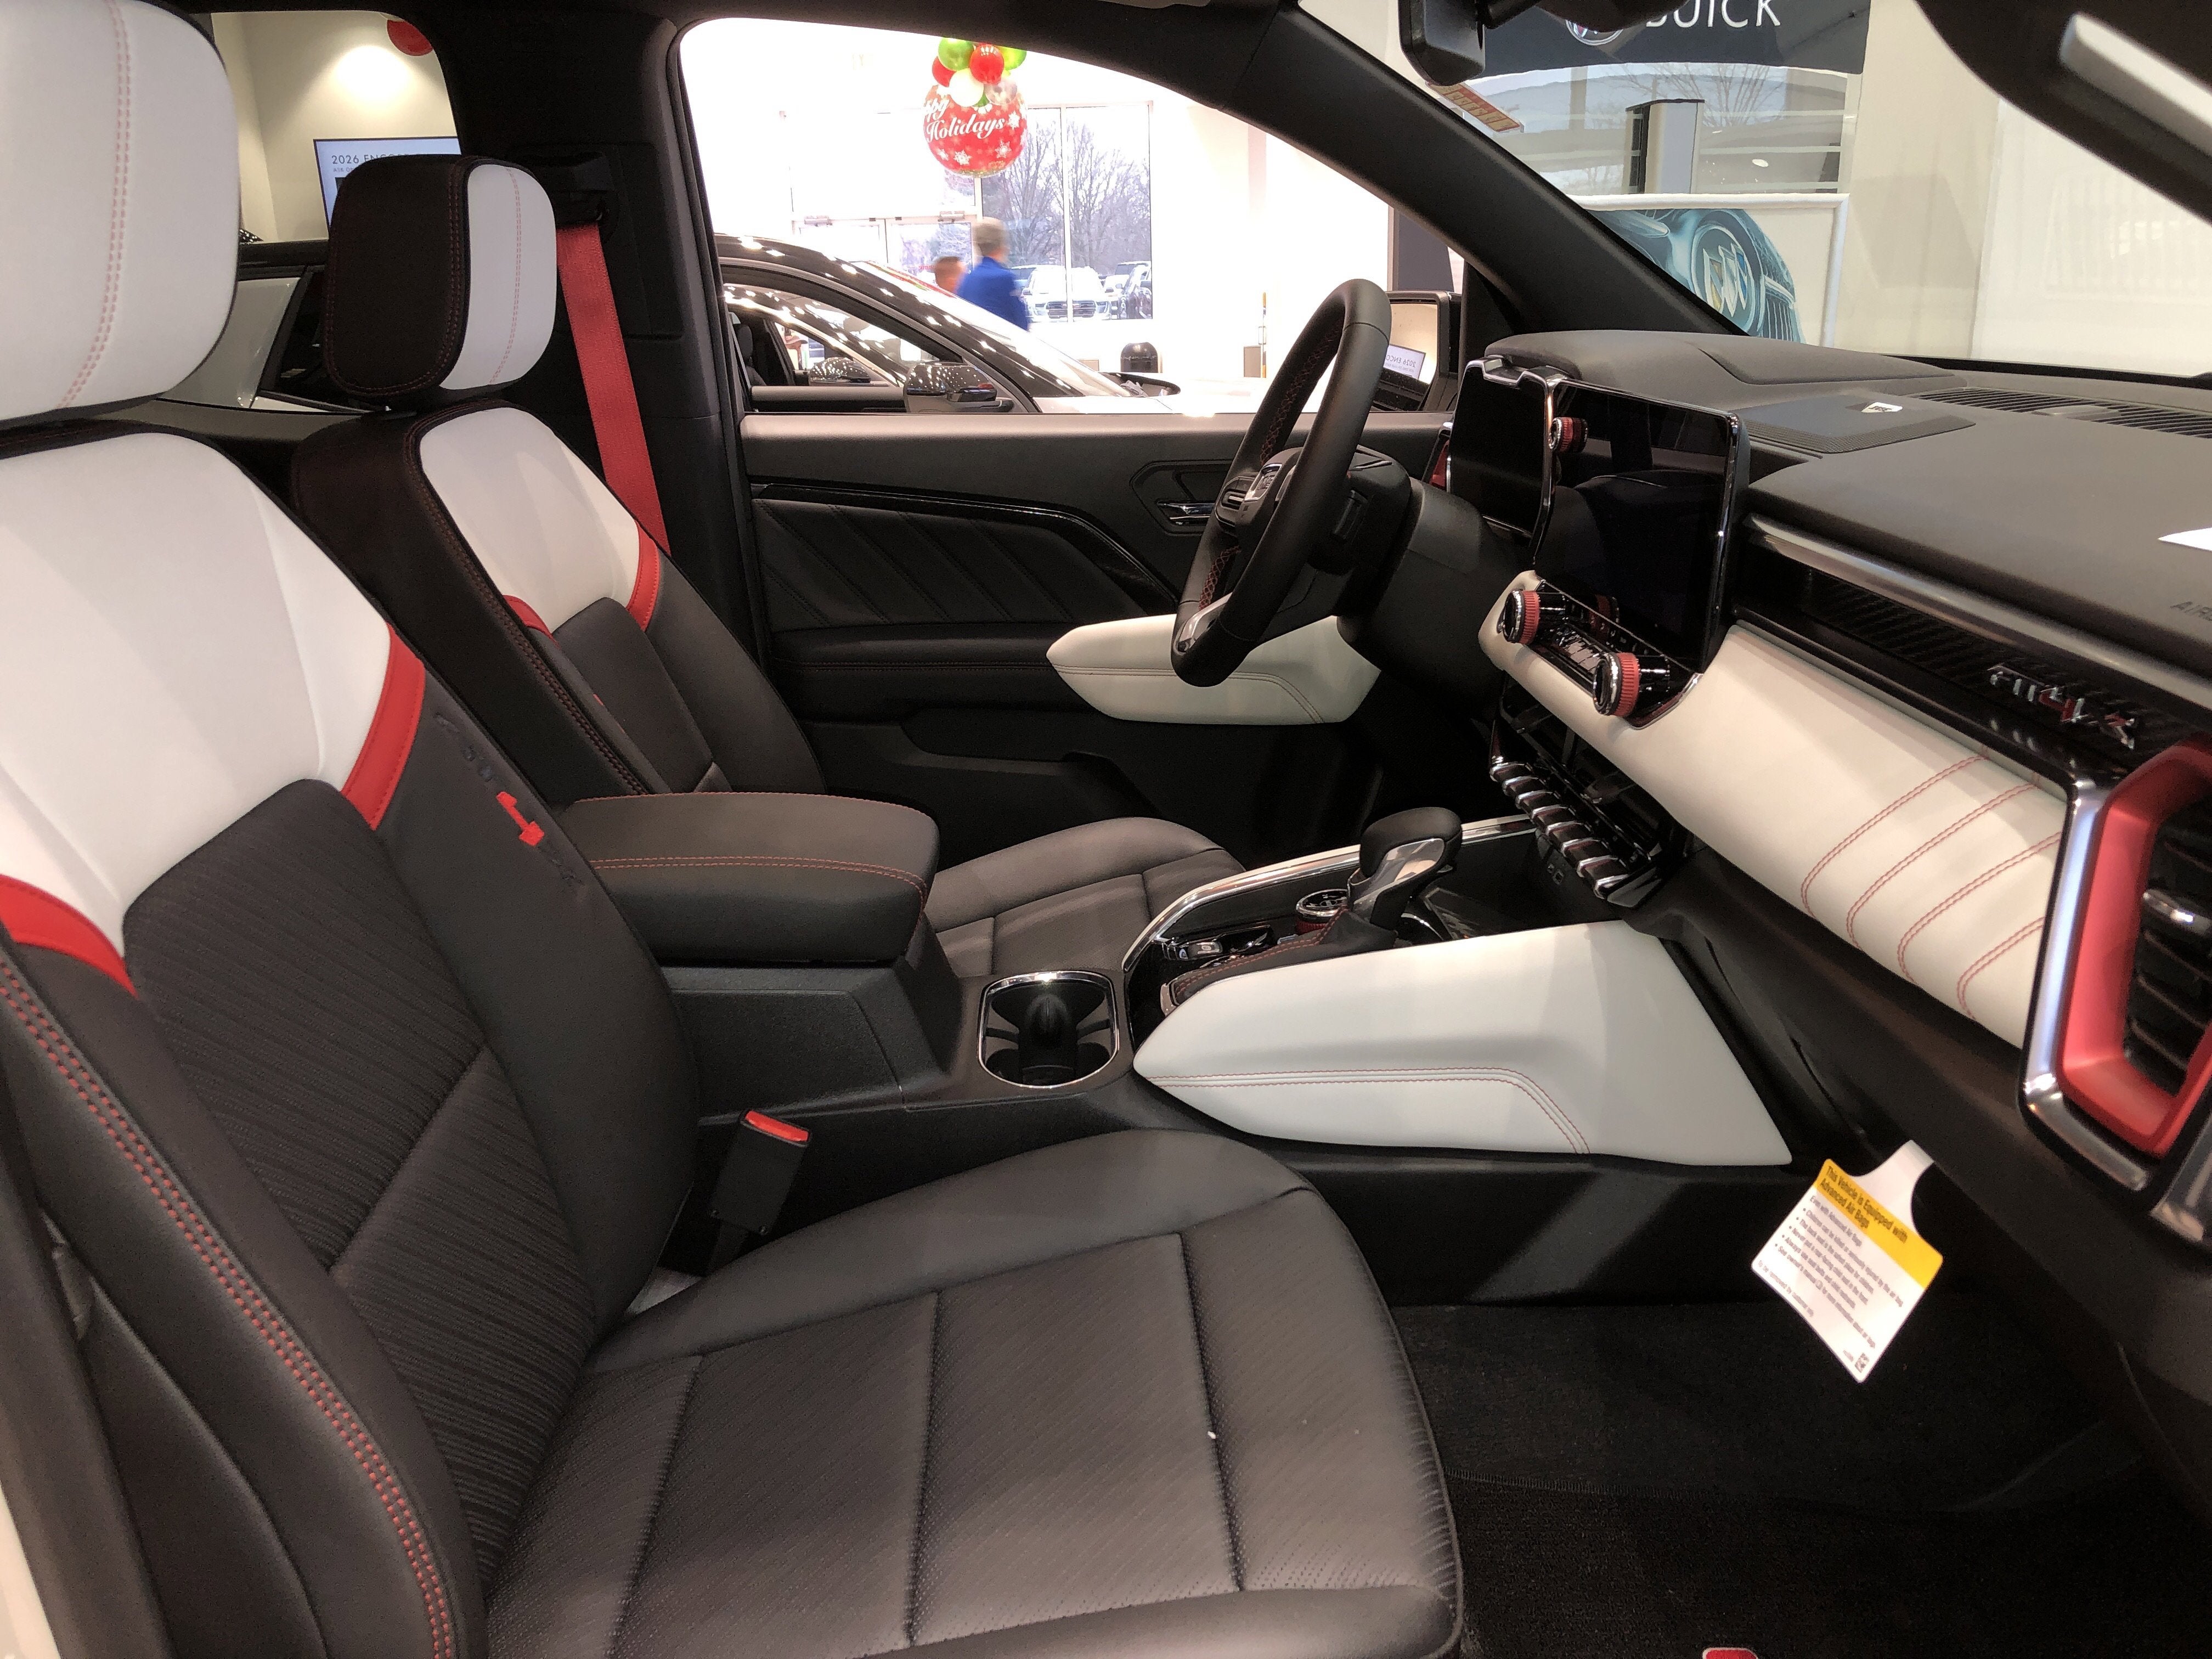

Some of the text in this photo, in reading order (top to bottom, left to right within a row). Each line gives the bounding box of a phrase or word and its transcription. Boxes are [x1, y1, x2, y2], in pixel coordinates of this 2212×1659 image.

[1646, 0, 1781, 28] UICK
[926, 114, 1005, 142] Holidays
[331, 155, 359, 164] 2026
[1819, 1178, 1870, 1229] Advanced Air Bags
[1826, 1165, 1838, 1182] This
[1837, 1176, 1858, 1200] Vehicle
[1863, 1199, 1894, 1231] Equipped
[1892, 1226, 1908, 1244] with
